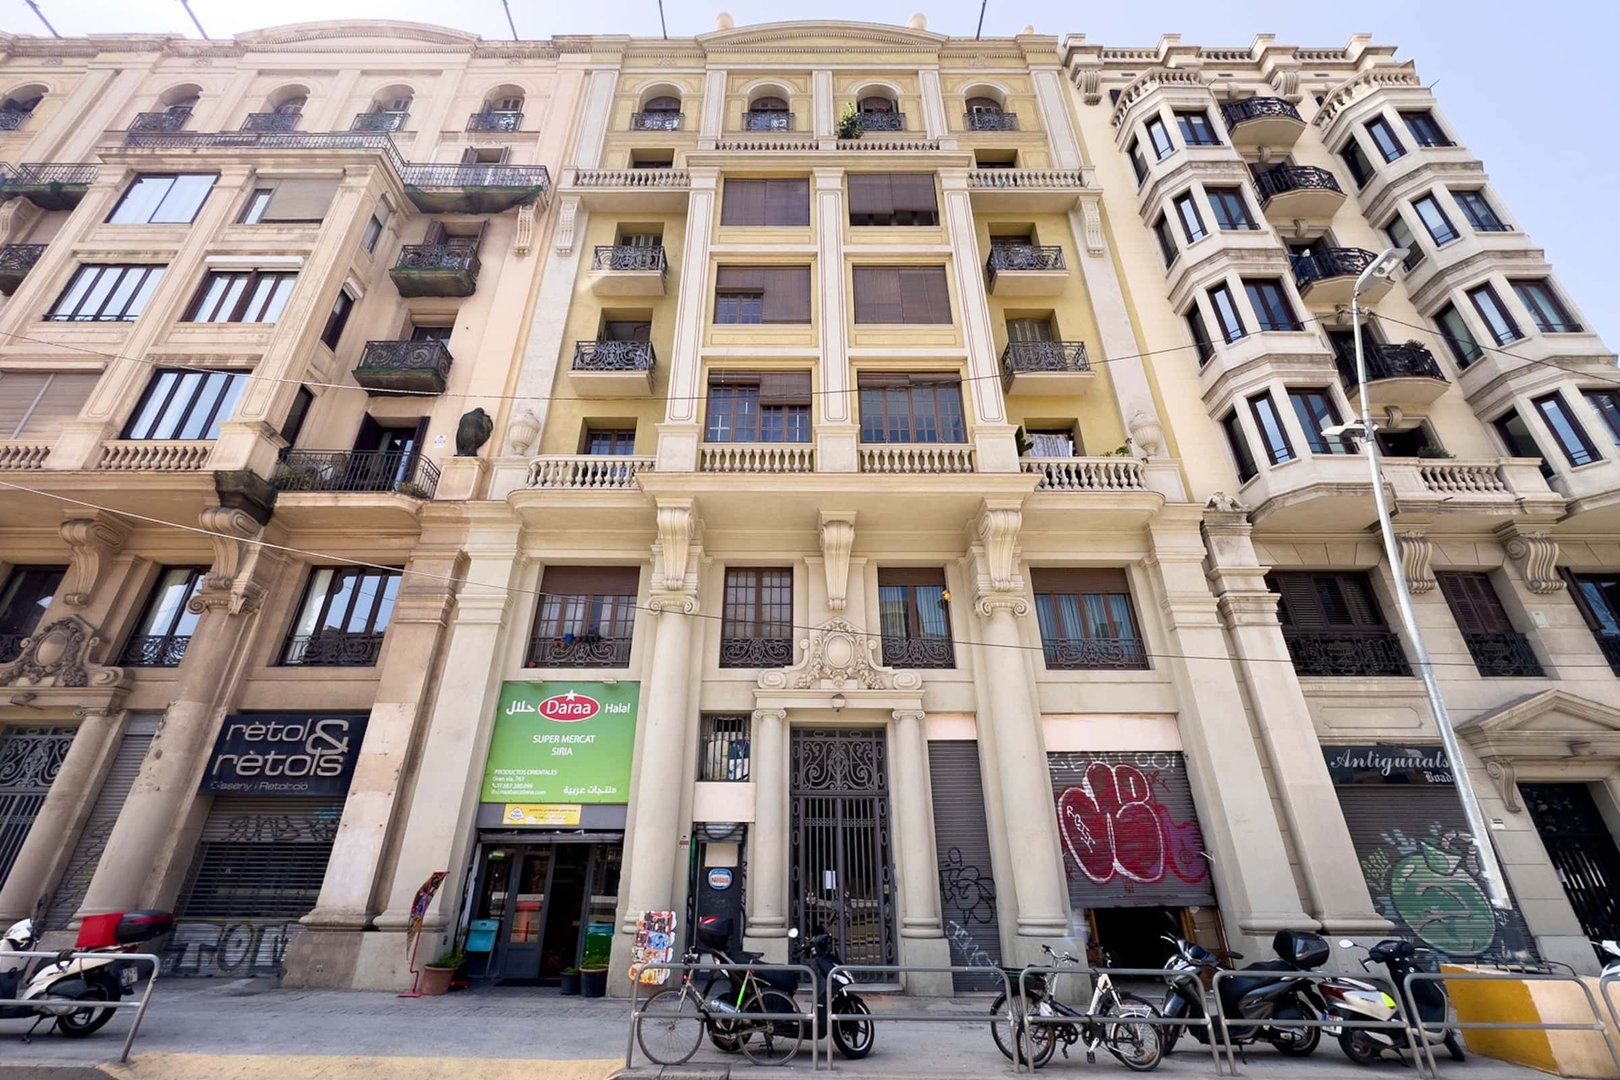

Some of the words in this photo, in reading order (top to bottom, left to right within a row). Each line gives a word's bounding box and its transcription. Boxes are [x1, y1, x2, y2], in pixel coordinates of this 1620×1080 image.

[506, 700, 535, 715] حلال
[546, 700, 591, 714] Daraa
[605, 703, 630, 713] Halal
[532, 735, 560, 743] SUPER
[561, 735, 595, 743] MERCAT
[551, 748, 573, 756] SIRIA
